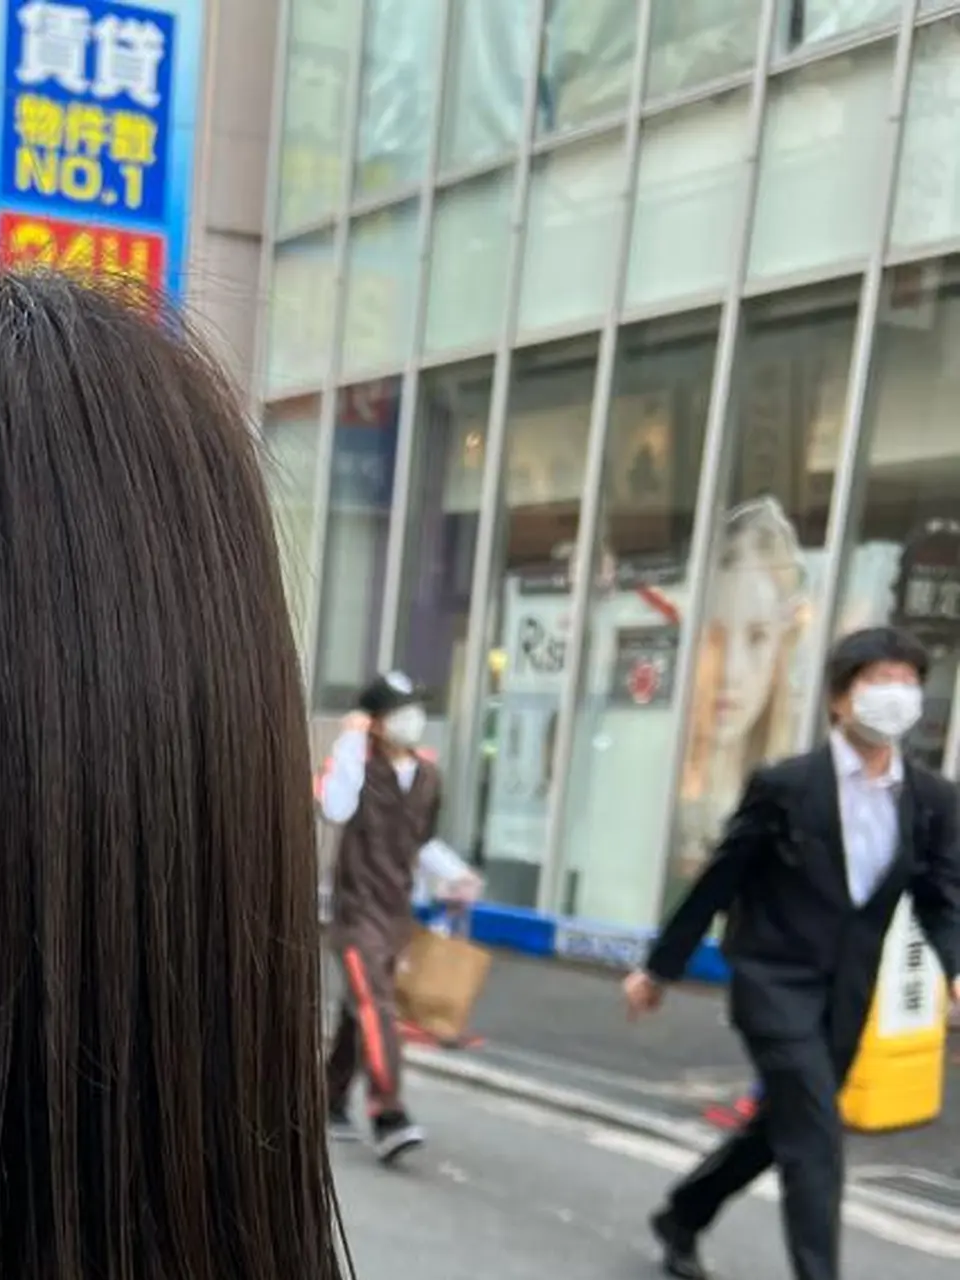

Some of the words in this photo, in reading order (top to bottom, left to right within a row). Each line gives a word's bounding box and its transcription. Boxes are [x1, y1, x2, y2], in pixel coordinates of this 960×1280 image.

[15, 2, 165, 108] 賃貸
[15, 94, 158, 166] 物件数
[14, 146, 144, 210] NO.1
